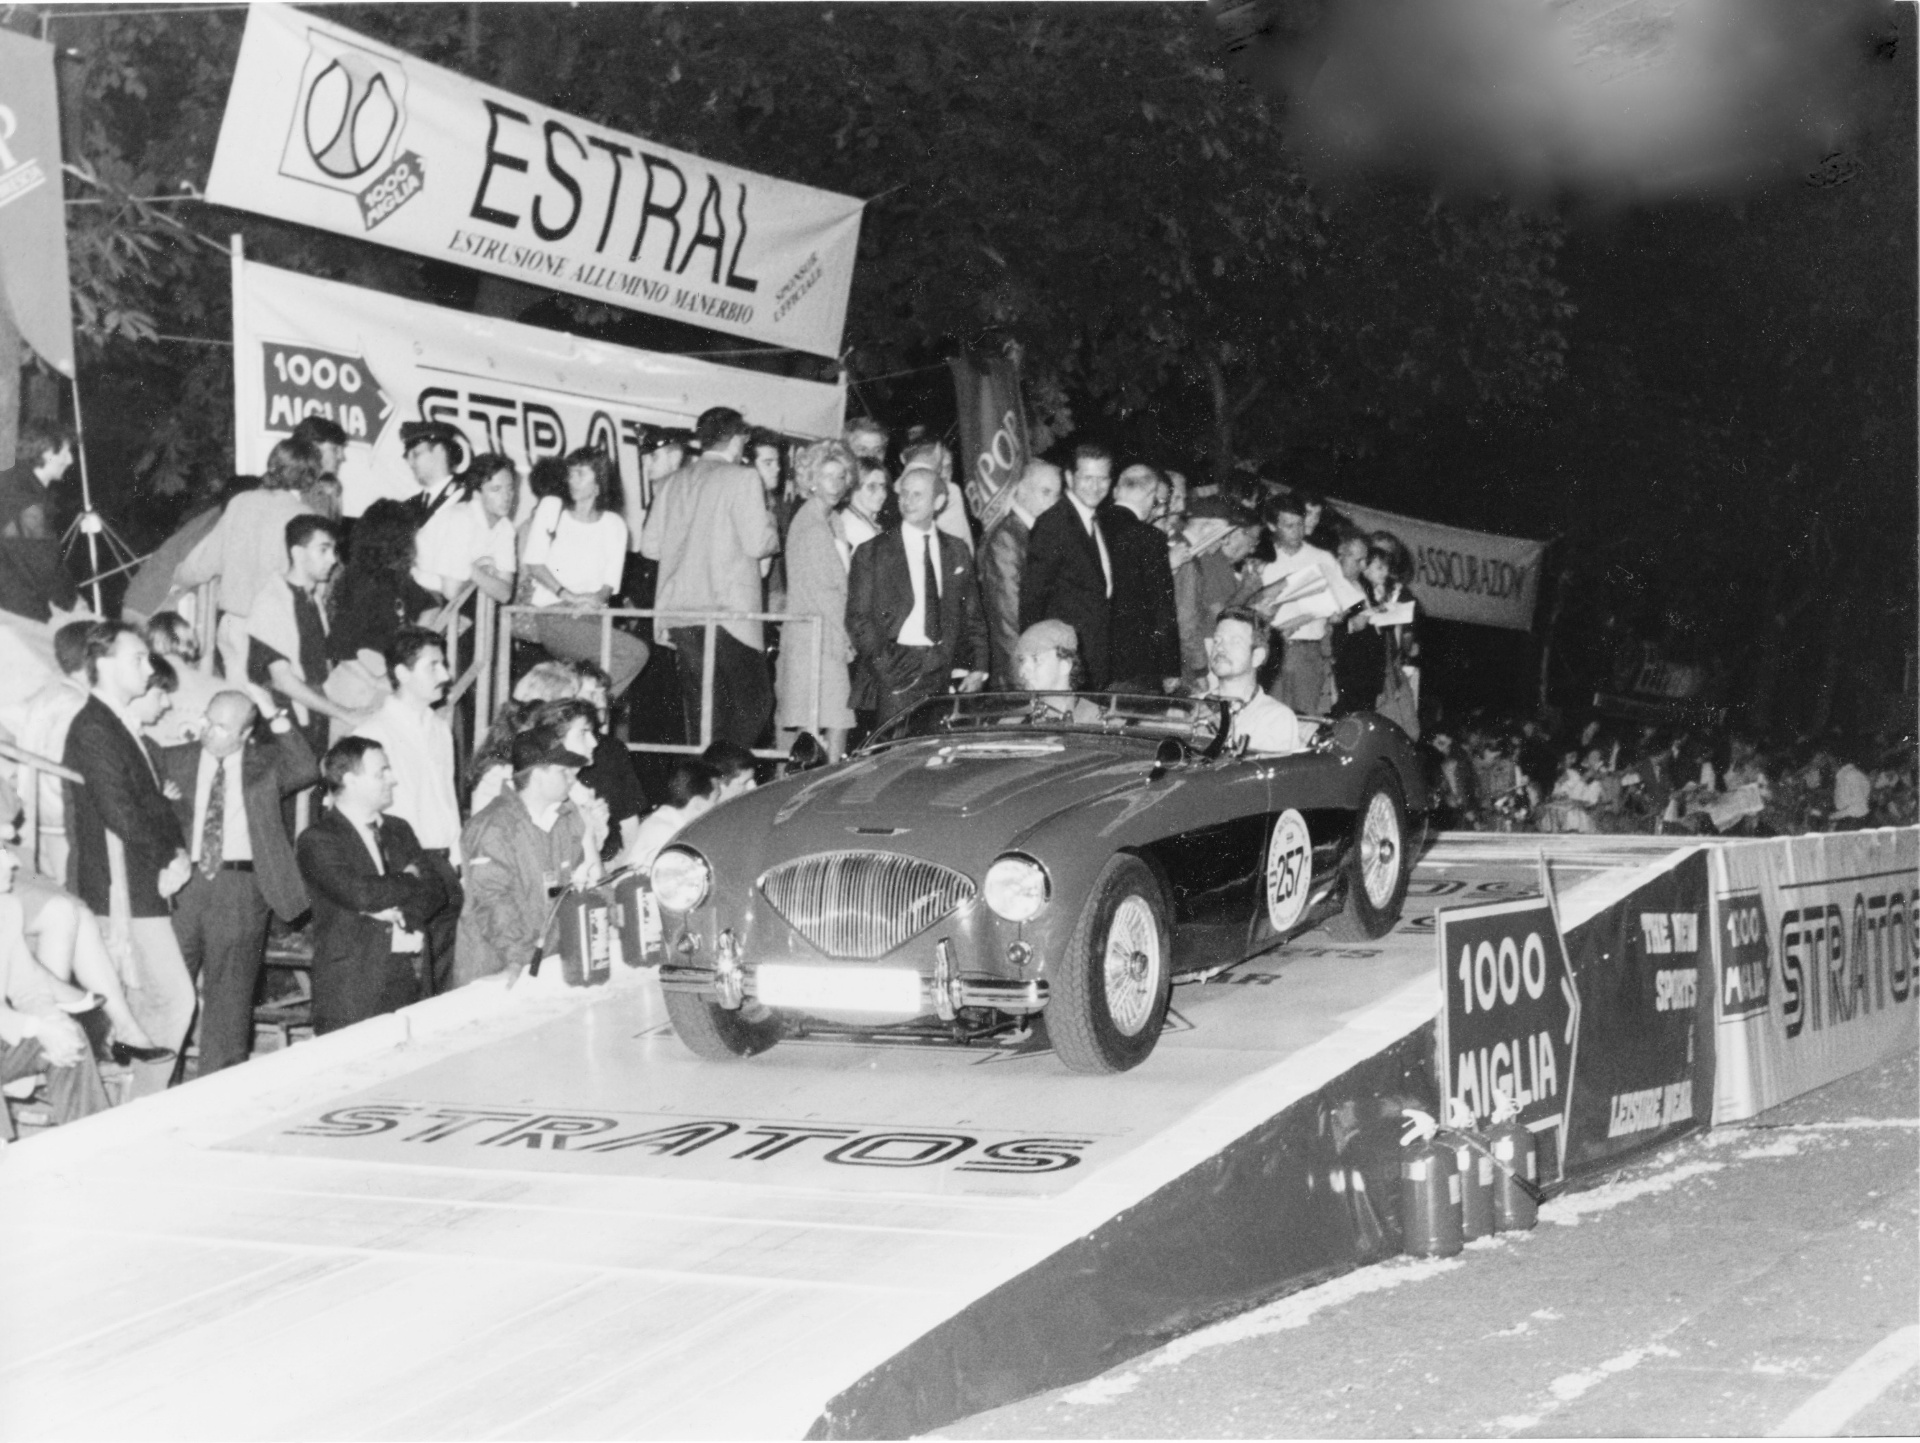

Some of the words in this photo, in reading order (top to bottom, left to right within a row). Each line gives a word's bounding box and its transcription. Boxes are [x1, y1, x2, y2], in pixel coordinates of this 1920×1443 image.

[365, 163, 409, 208] 1000
[470, 99, 758, 292] ESTRAL
[448, 230, 573, 279] ESTRUSIONE
[573, 264, 669, 304] ALLUMINIO
[273, 351, 361, 393] 1000
[1276, 845, 1304, 904] 257
[1459, 932, 1547, 1014] 1000
[1456, 1030, 1558, 1119] MIGLIA
[284, 1104, 1093, 1174] STRATOS
